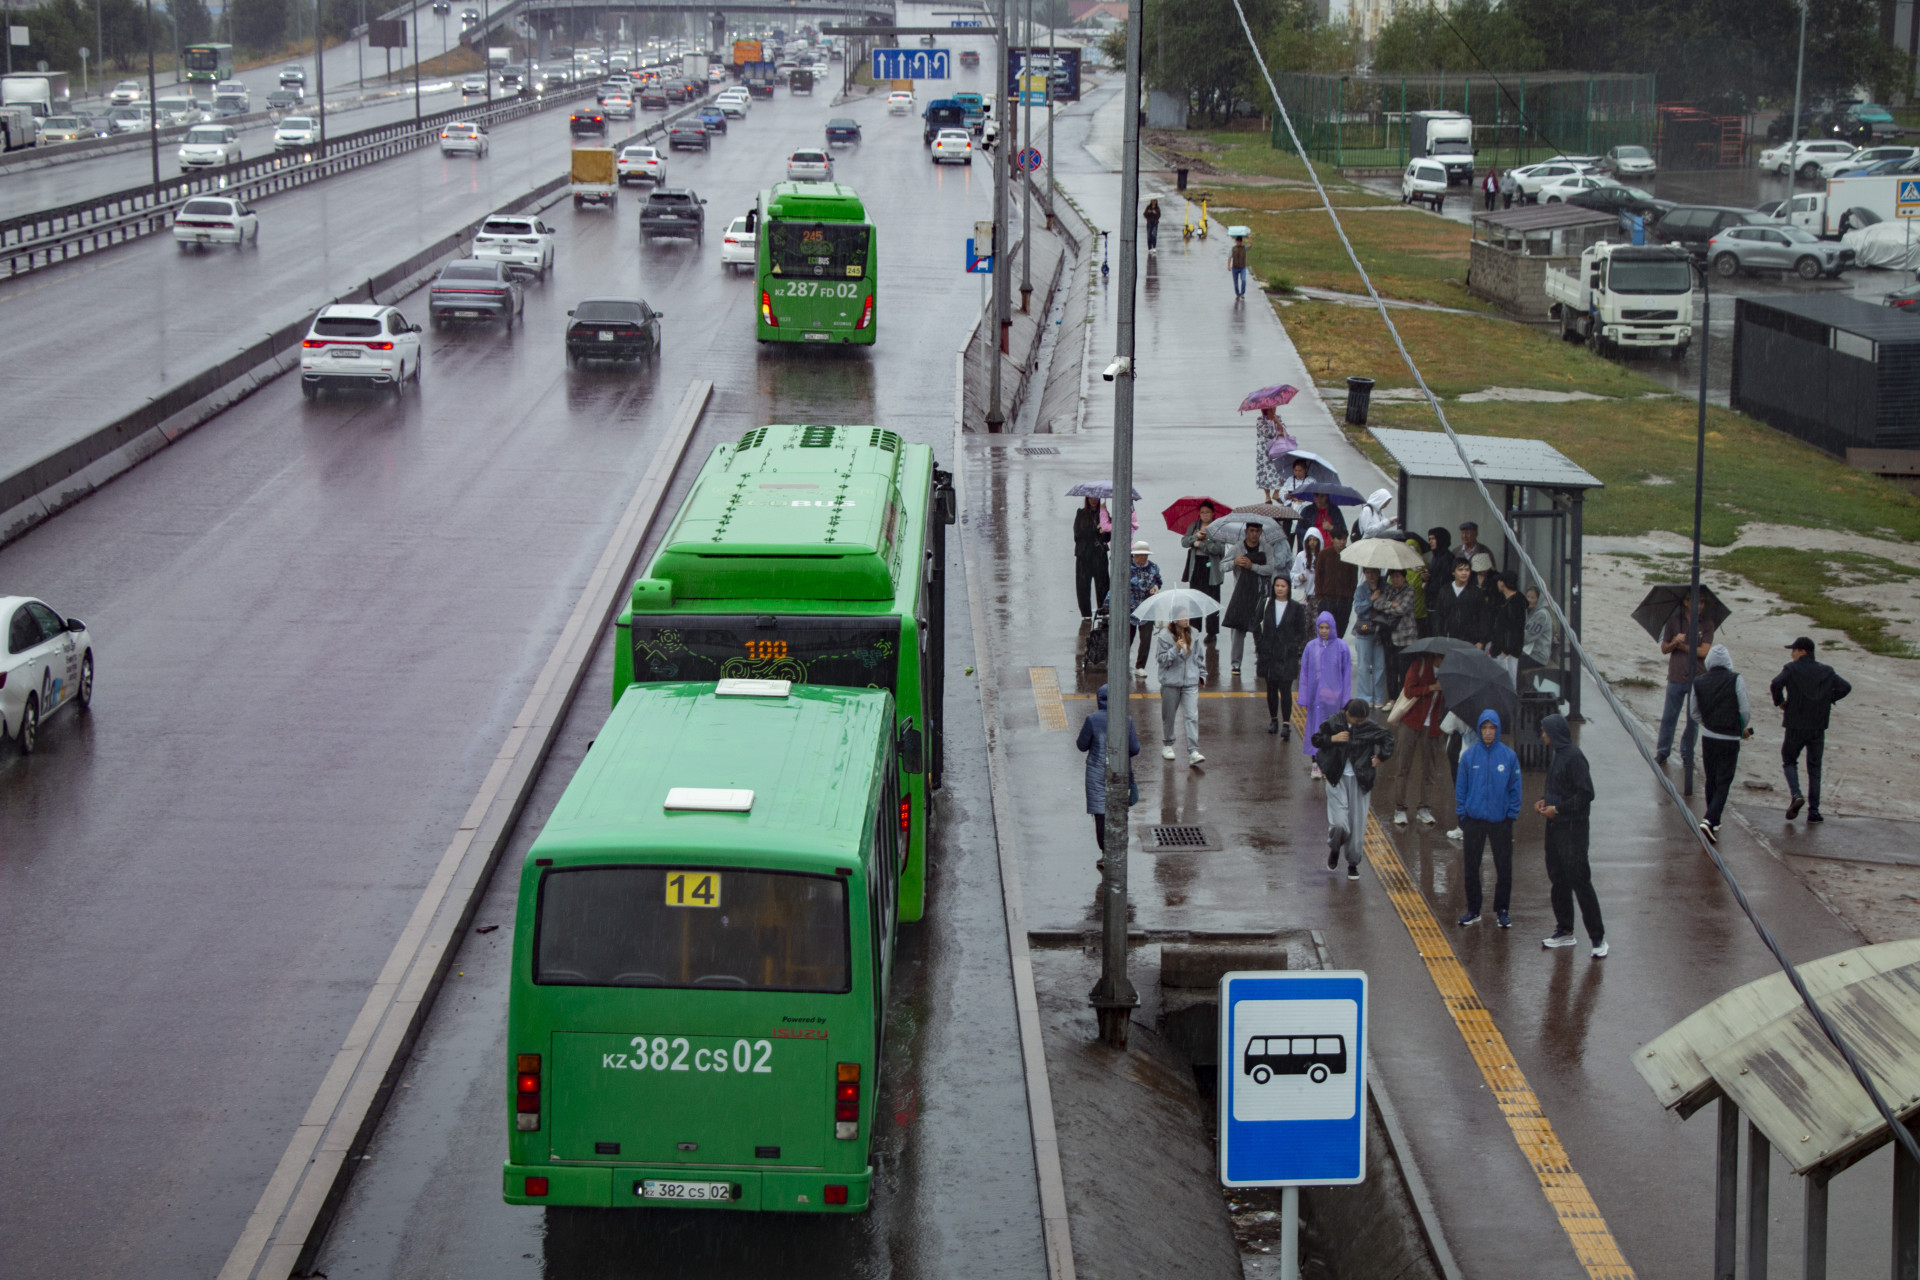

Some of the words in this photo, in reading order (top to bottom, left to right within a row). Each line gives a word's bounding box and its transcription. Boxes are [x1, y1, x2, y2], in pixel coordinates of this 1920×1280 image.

[803, 230, 823, 241] 245
[808, 256, 830, 265] ECOBUS
[787, 282, 818, 297] 287
[820, 288, 834, 297] FD
[836, 284, 858, 298] 02
[745, 640, 788, 659] 100
[670, 875, 714, 905] 14
[817, 1016, 827, 1024] by
[772, 1028, 828, 1040] ISUZU
[602, 1053, 628, 1069] KZ
[629, 1036, 690, 1071] 382
[733, 1039, 773, 1073] 02
[659, 1183, 684, 1198] 382
[688, 1187, 705, 1198] CS
[711, 1185, 729, 1199] 02
